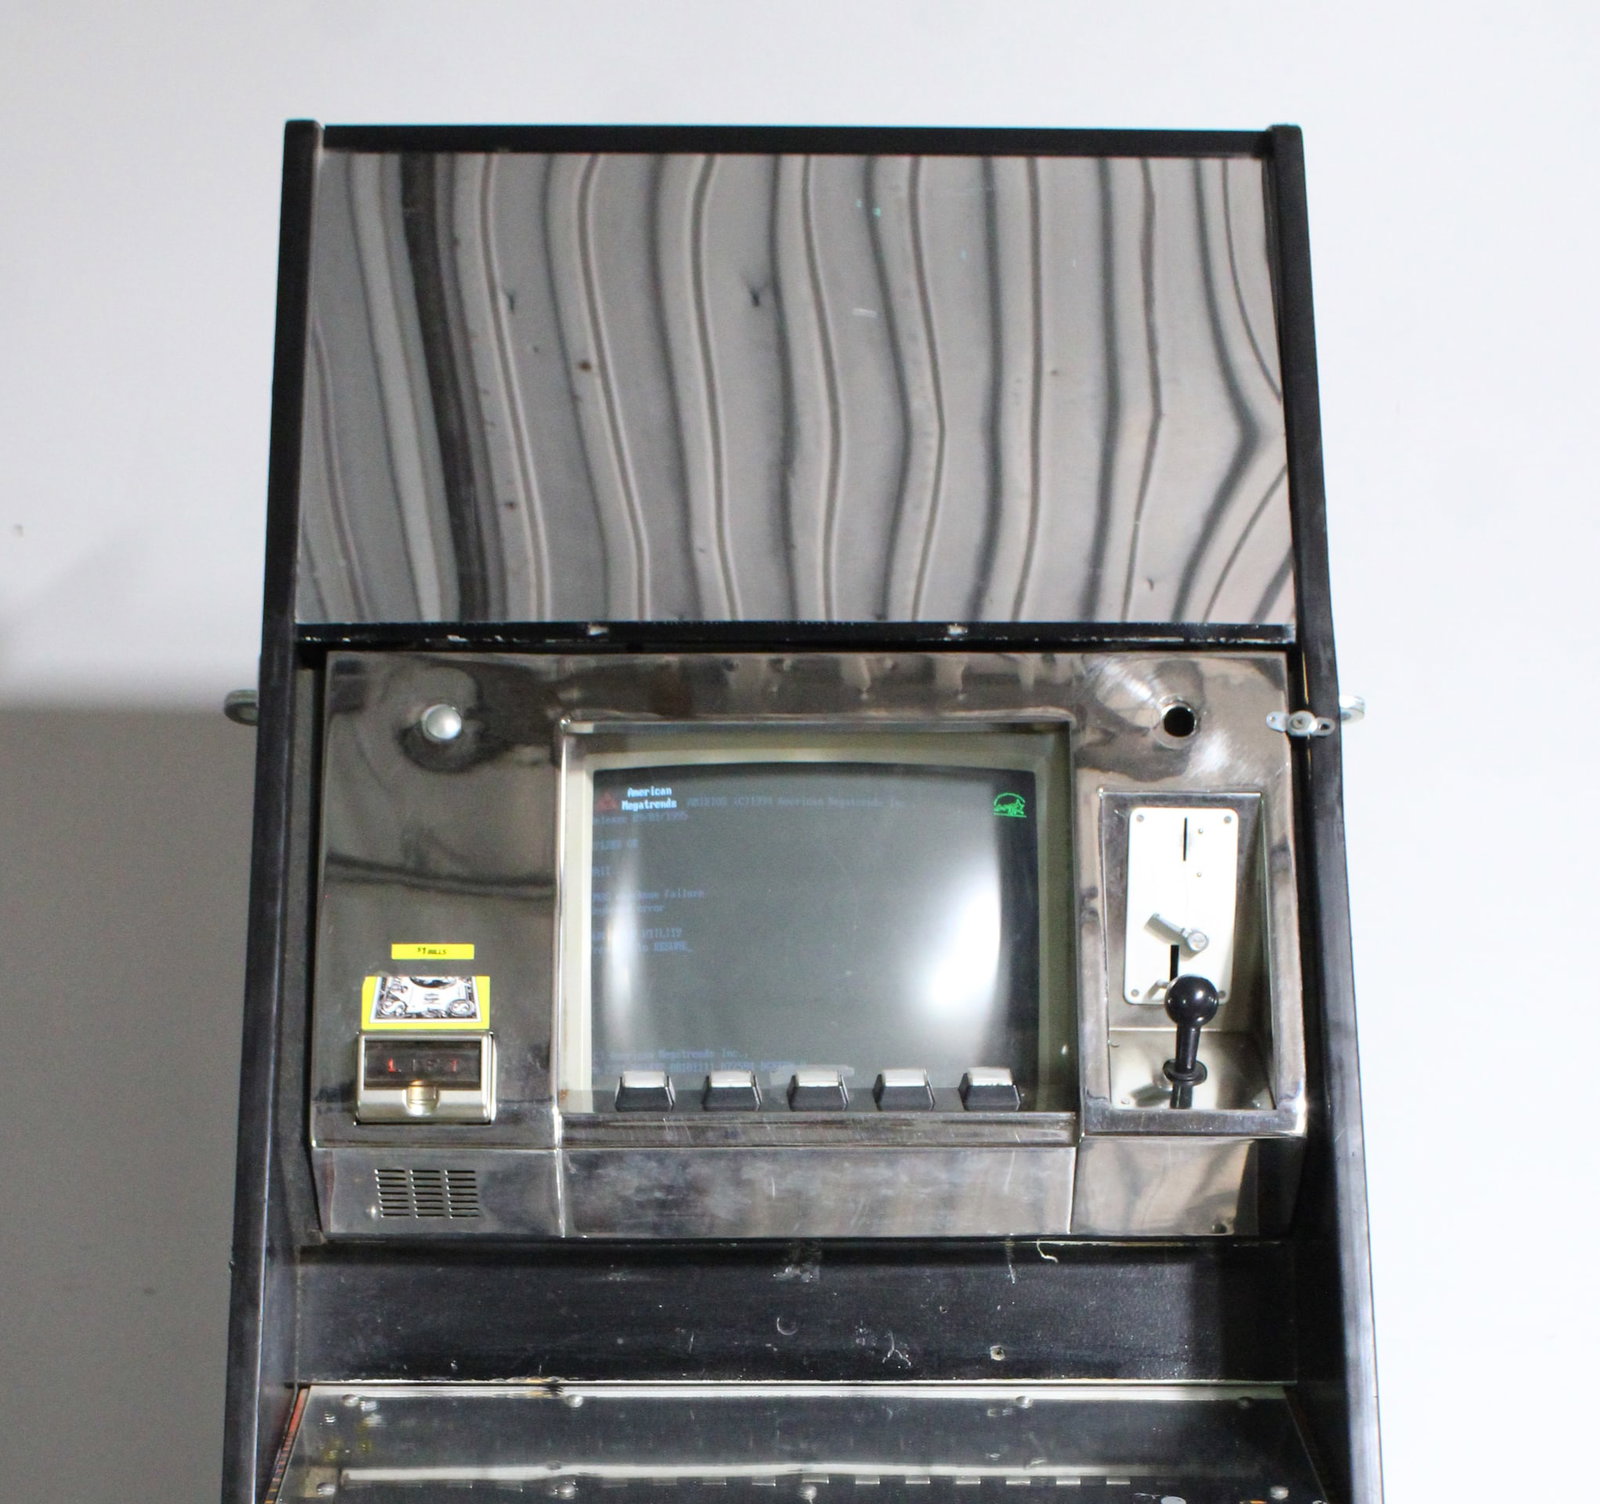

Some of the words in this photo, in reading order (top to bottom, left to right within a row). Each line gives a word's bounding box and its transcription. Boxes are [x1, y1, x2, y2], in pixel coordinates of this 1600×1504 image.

[627, 786, 672, 797] American
[621, 797, 677, 812] Megatrends
[664, 888, 705, 899] failure
